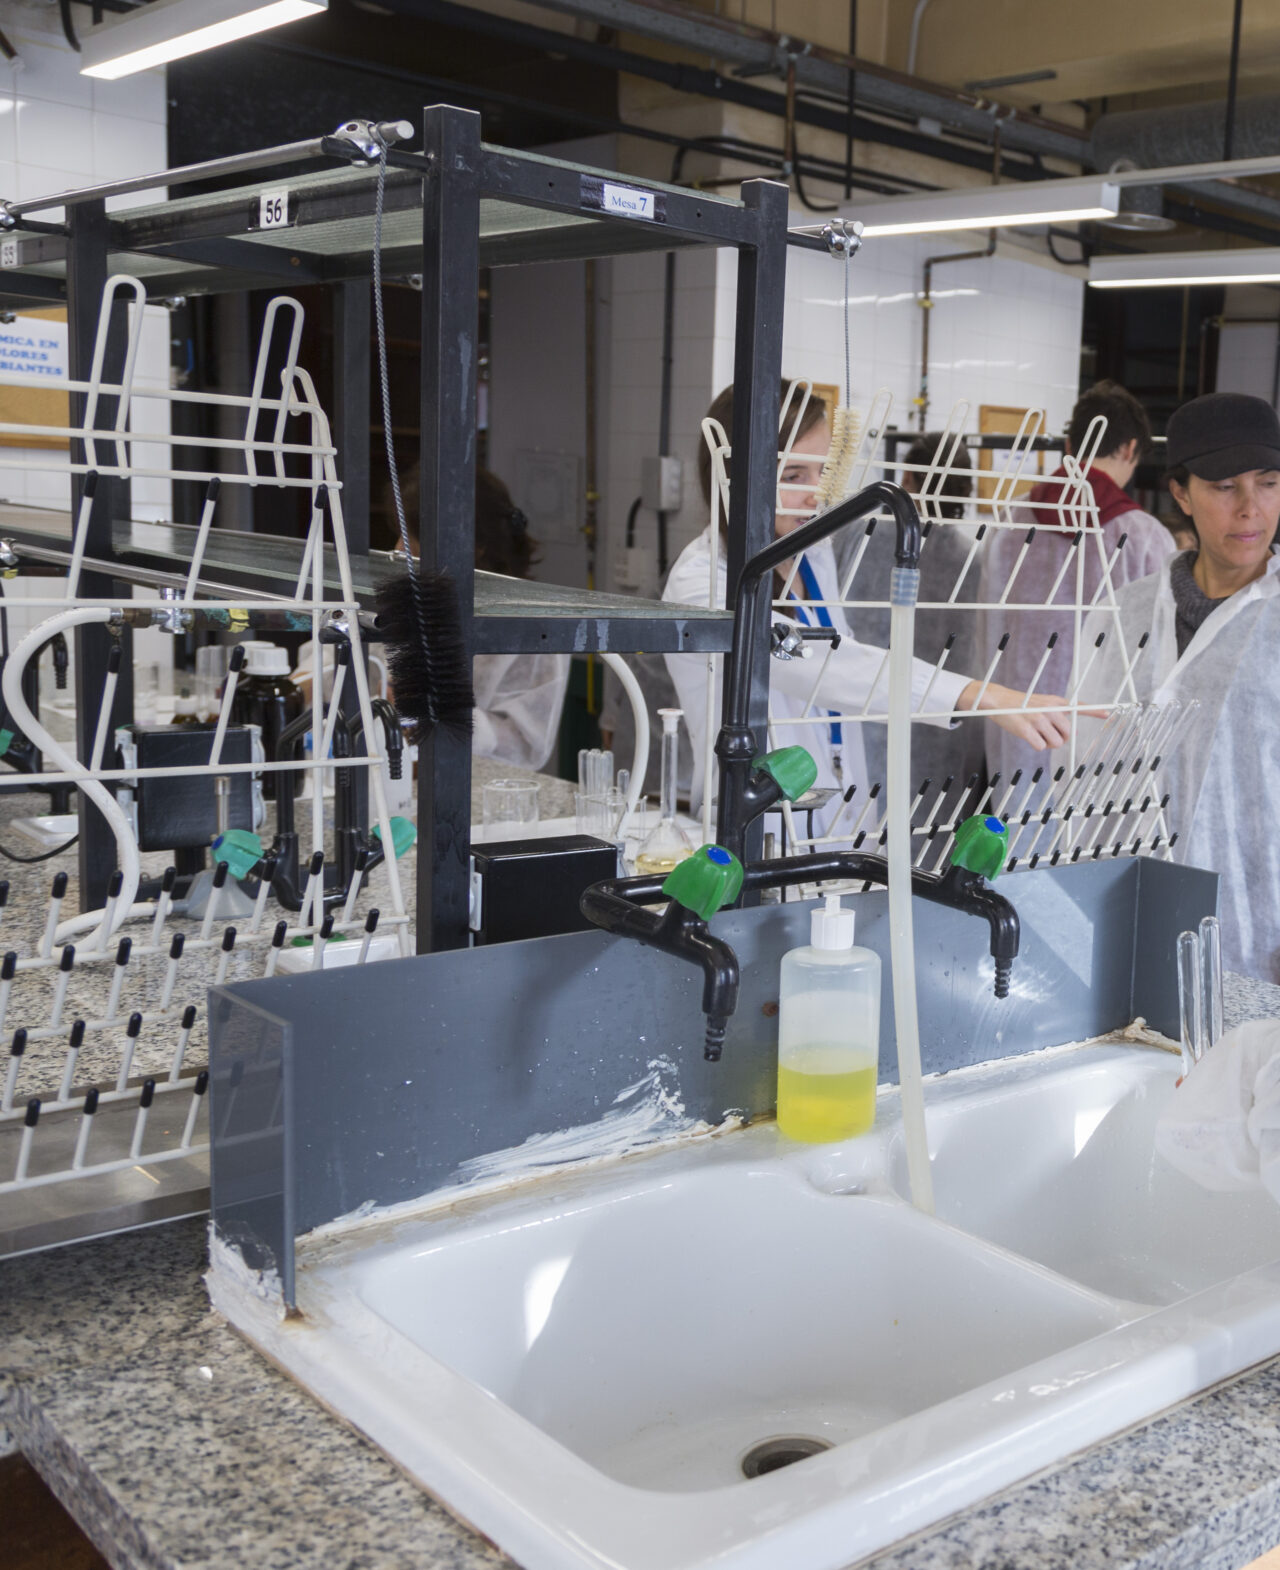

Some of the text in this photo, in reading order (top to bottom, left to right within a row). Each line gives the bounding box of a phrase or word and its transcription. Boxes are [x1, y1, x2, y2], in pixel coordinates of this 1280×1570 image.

[612, 195, 647, 211] Mesa 7
[266, 198, 282, 224] 56
[39, 339, 59, 349] EN
[0, 347, 48, 361] LORES
